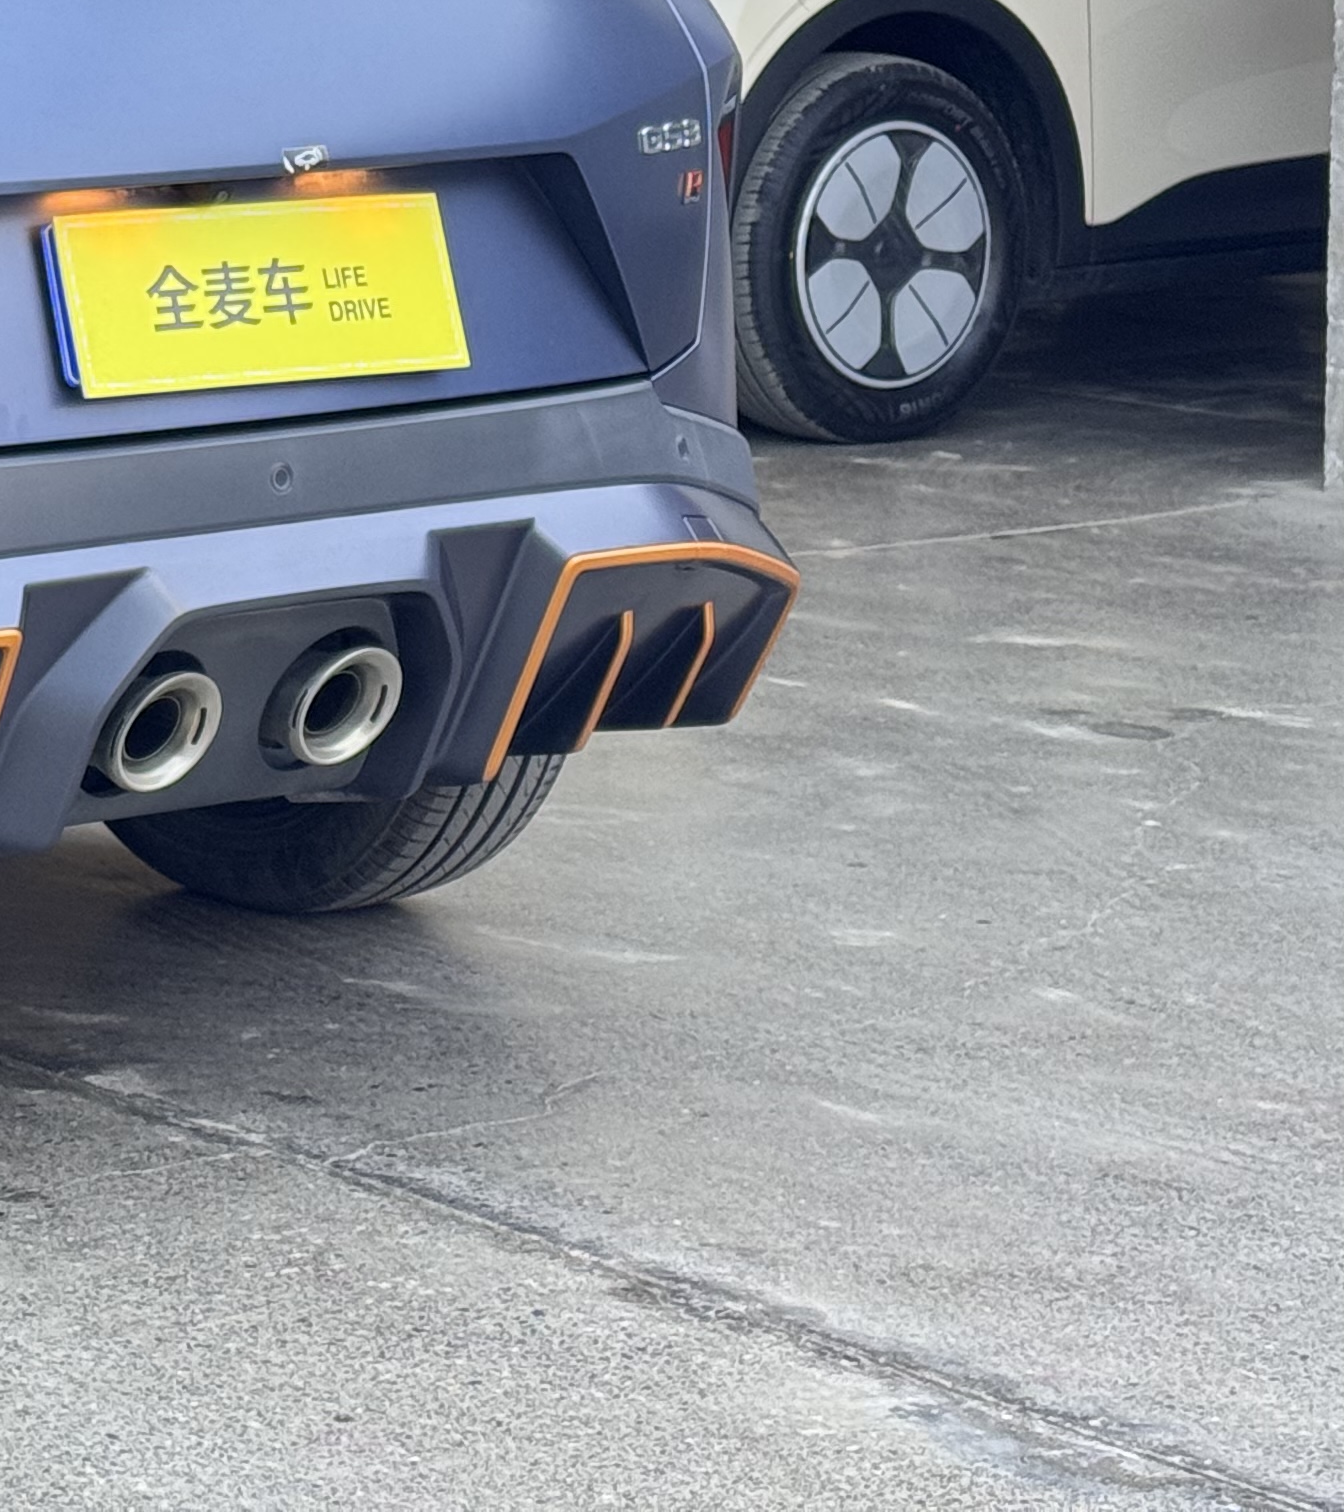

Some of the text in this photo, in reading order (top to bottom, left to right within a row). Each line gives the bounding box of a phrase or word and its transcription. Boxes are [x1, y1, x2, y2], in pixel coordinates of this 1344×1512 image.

[322, 265, 368, 289] LIFE
[146, 257, 314, 333] 全麦车
[329, 297, 393, 323] DRIVE
